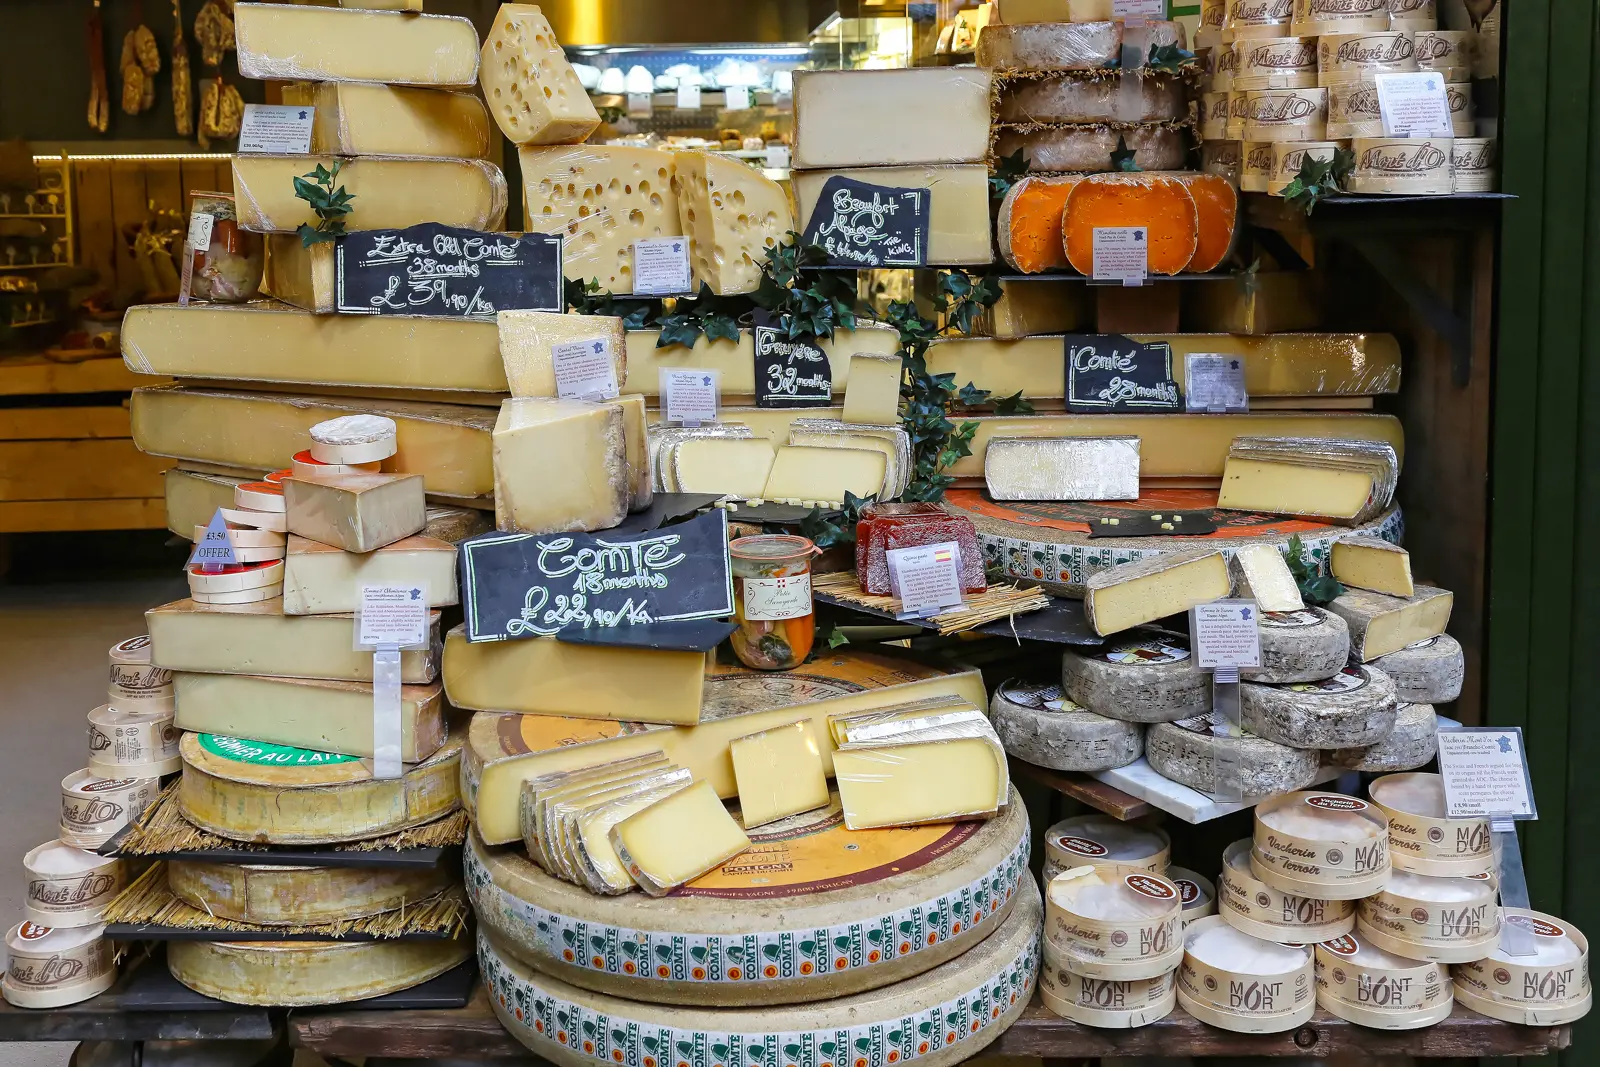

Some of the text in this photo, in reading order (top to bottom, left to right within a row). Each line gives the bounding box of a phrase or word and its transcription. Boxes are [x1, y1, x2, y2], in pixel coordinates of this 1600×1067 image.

[1360, 142, 1446, 170] Mont d'Or
[833, 189, 899, 228] Beaufort
[367, 236, 431, 258] Extra
[433, 234, 462, 256] Old
[1074, 346, 1137, 373] Comté
[207, 532, 225, 540] £3.50
[199, 548, 230, 557] OFFER
[110, 664, 140, 686] Mont
[259, 753, 293, 762] AU
[79, 796, 123, 822] d'Or
[1268, 836, 1316, 859] Vacherin
[723, 863, 793, 873] POLIGNY
[1264, 851, 1320, 875] du Terroir
[29, 872, 115, 902] Mont d'Or
[815, 879, 854, 890] POLIGNY
[884, 916, 892, 960] COMTE
[914, 906, 922, 951] COMTE
[1055, 916, 1101, 941] Vacherin
[672, 936, 684, 980] COMTE
[709, 937, 720, 980] COMTE
[744, 934, 756, 980] COMTE
[780, 932, 792, 978] COMTE
[816, 929, 828, 974] COMTE
[852, 924, 860, 968] COMTE
[35, 955, 83, 983] d'Or
[569, 1004, 579, 1050] COMTE
[597, 1014, 608, 1059] COMTE
[902, 1016, 912, 1060] COMTE
[932, 1008, 941, 1051] COMTE
[627, 1022, 638, 1066] COMTE
